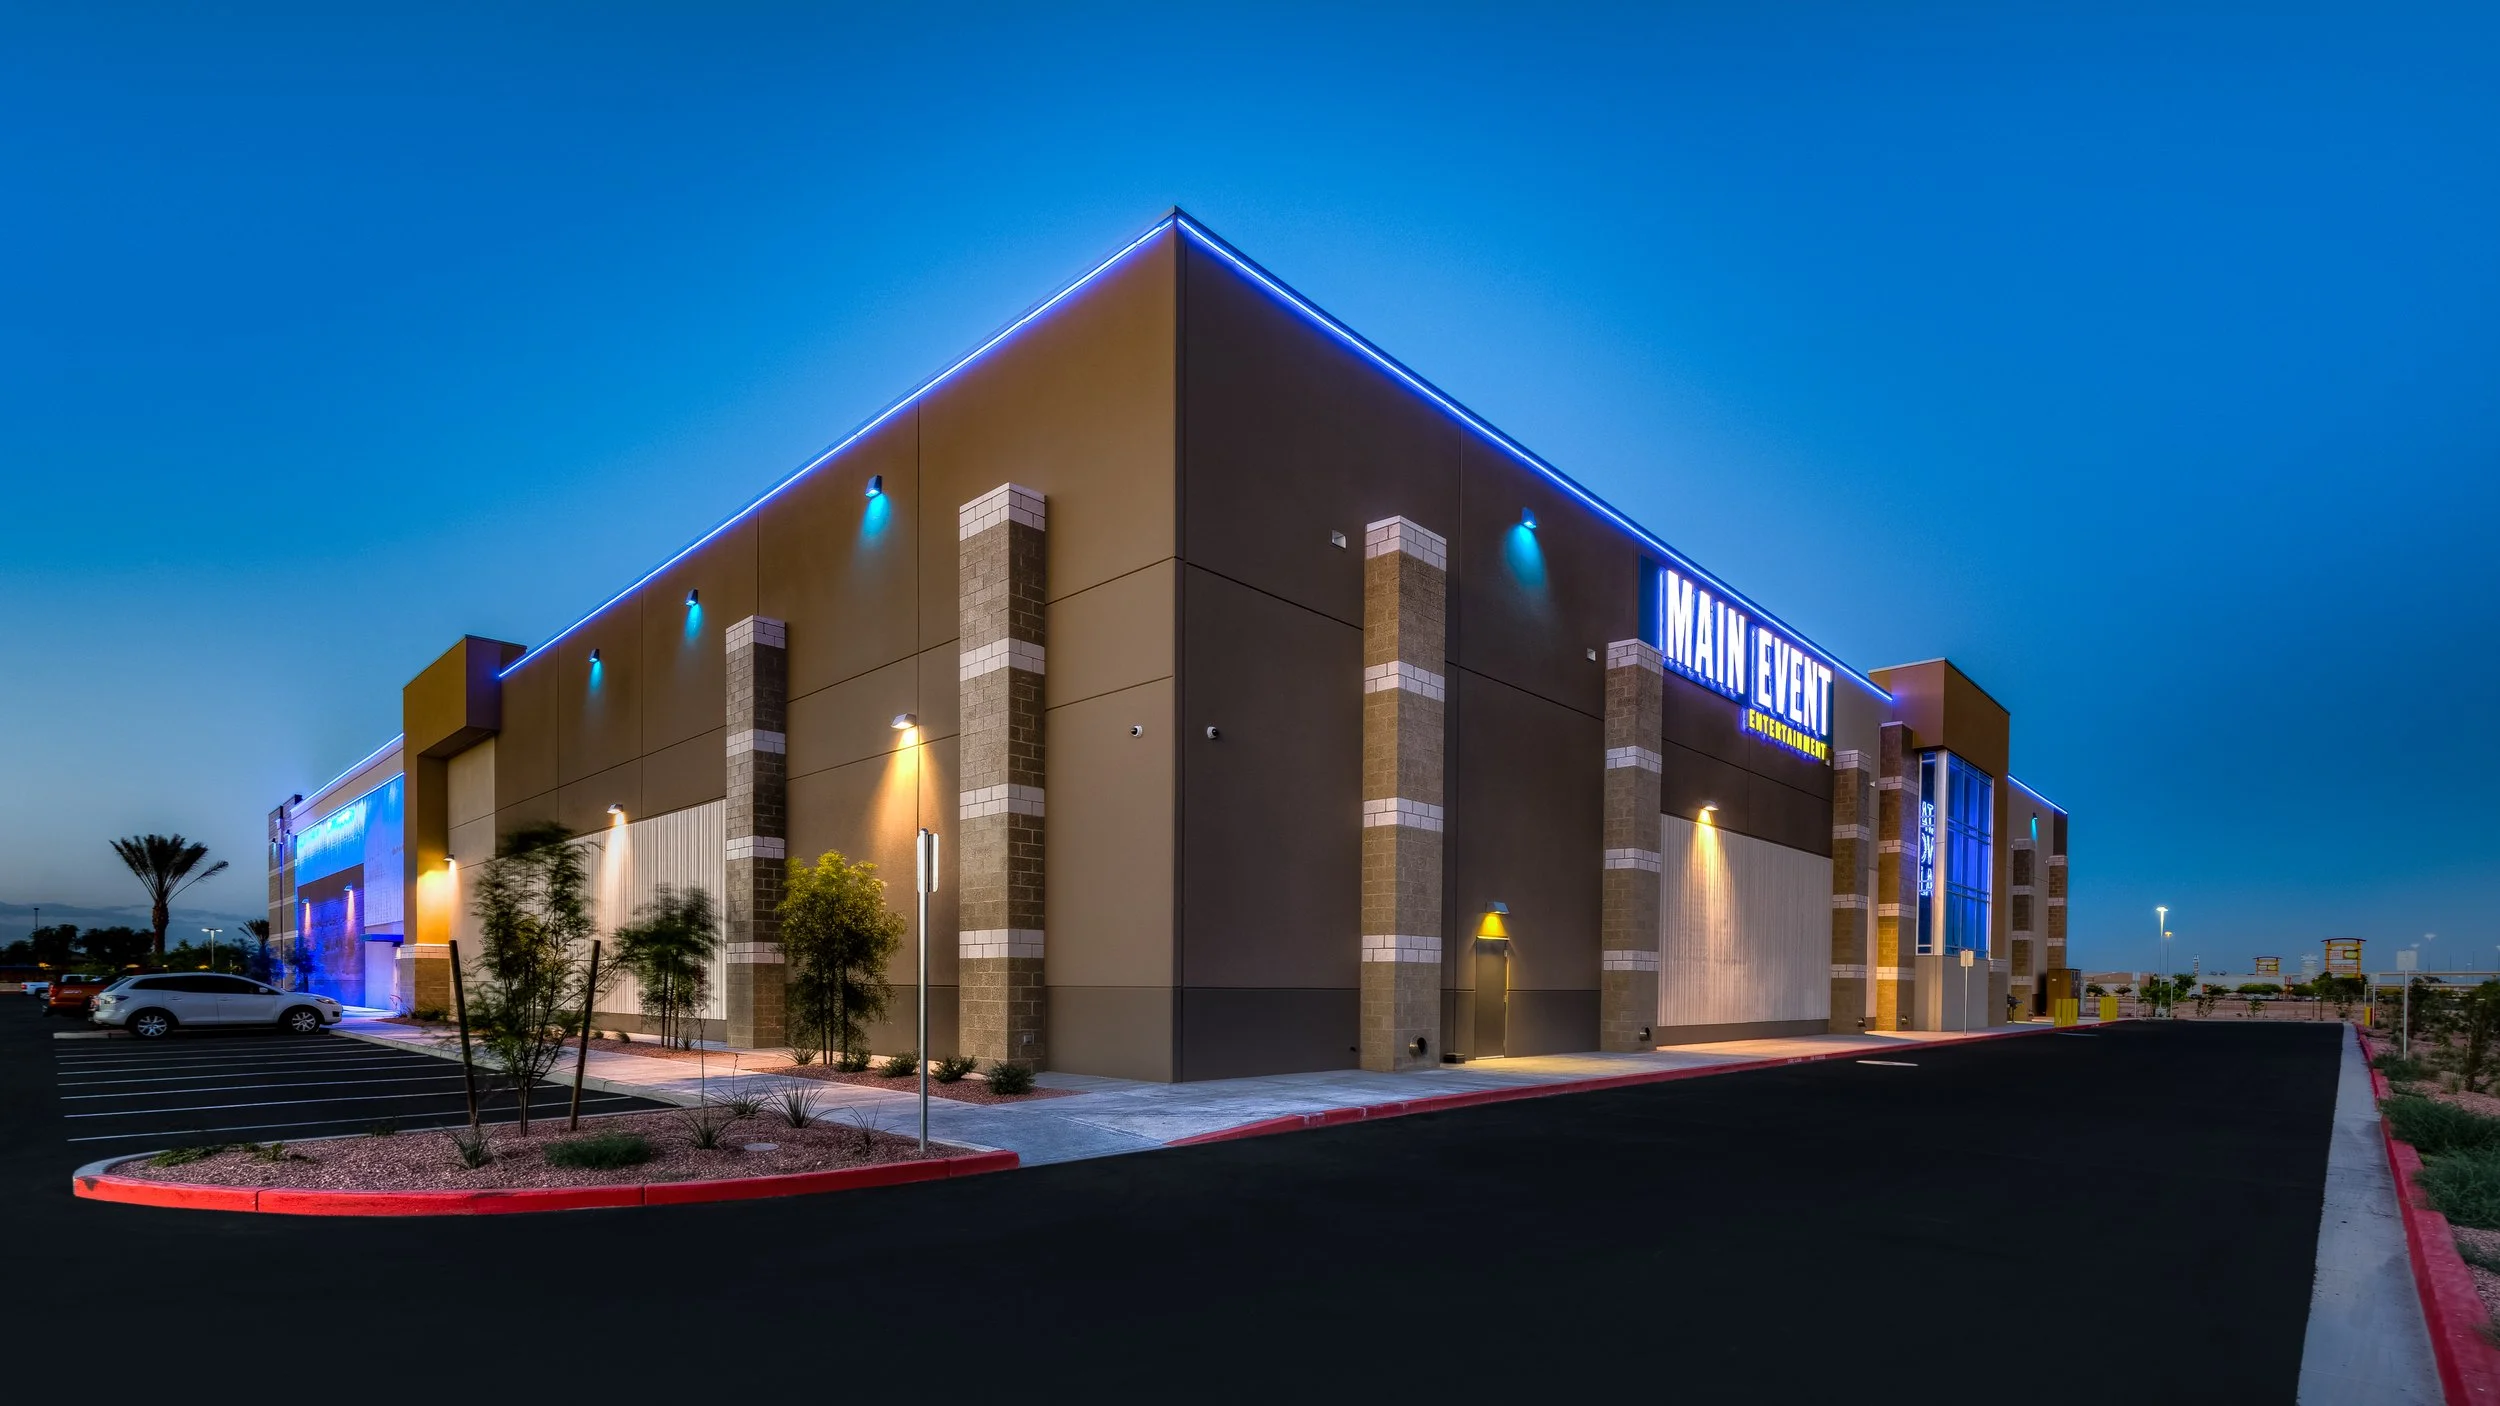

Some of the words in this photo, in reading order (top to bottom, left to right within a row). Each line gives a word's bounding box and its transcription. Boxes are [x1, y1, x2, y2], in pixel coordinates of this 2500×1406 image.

[1667, 569, 1745, 695] MAIN
[1757, 626, 1832, 737] EVENT
[1748, 708, 1828, 761] ENTERTAINMENT
